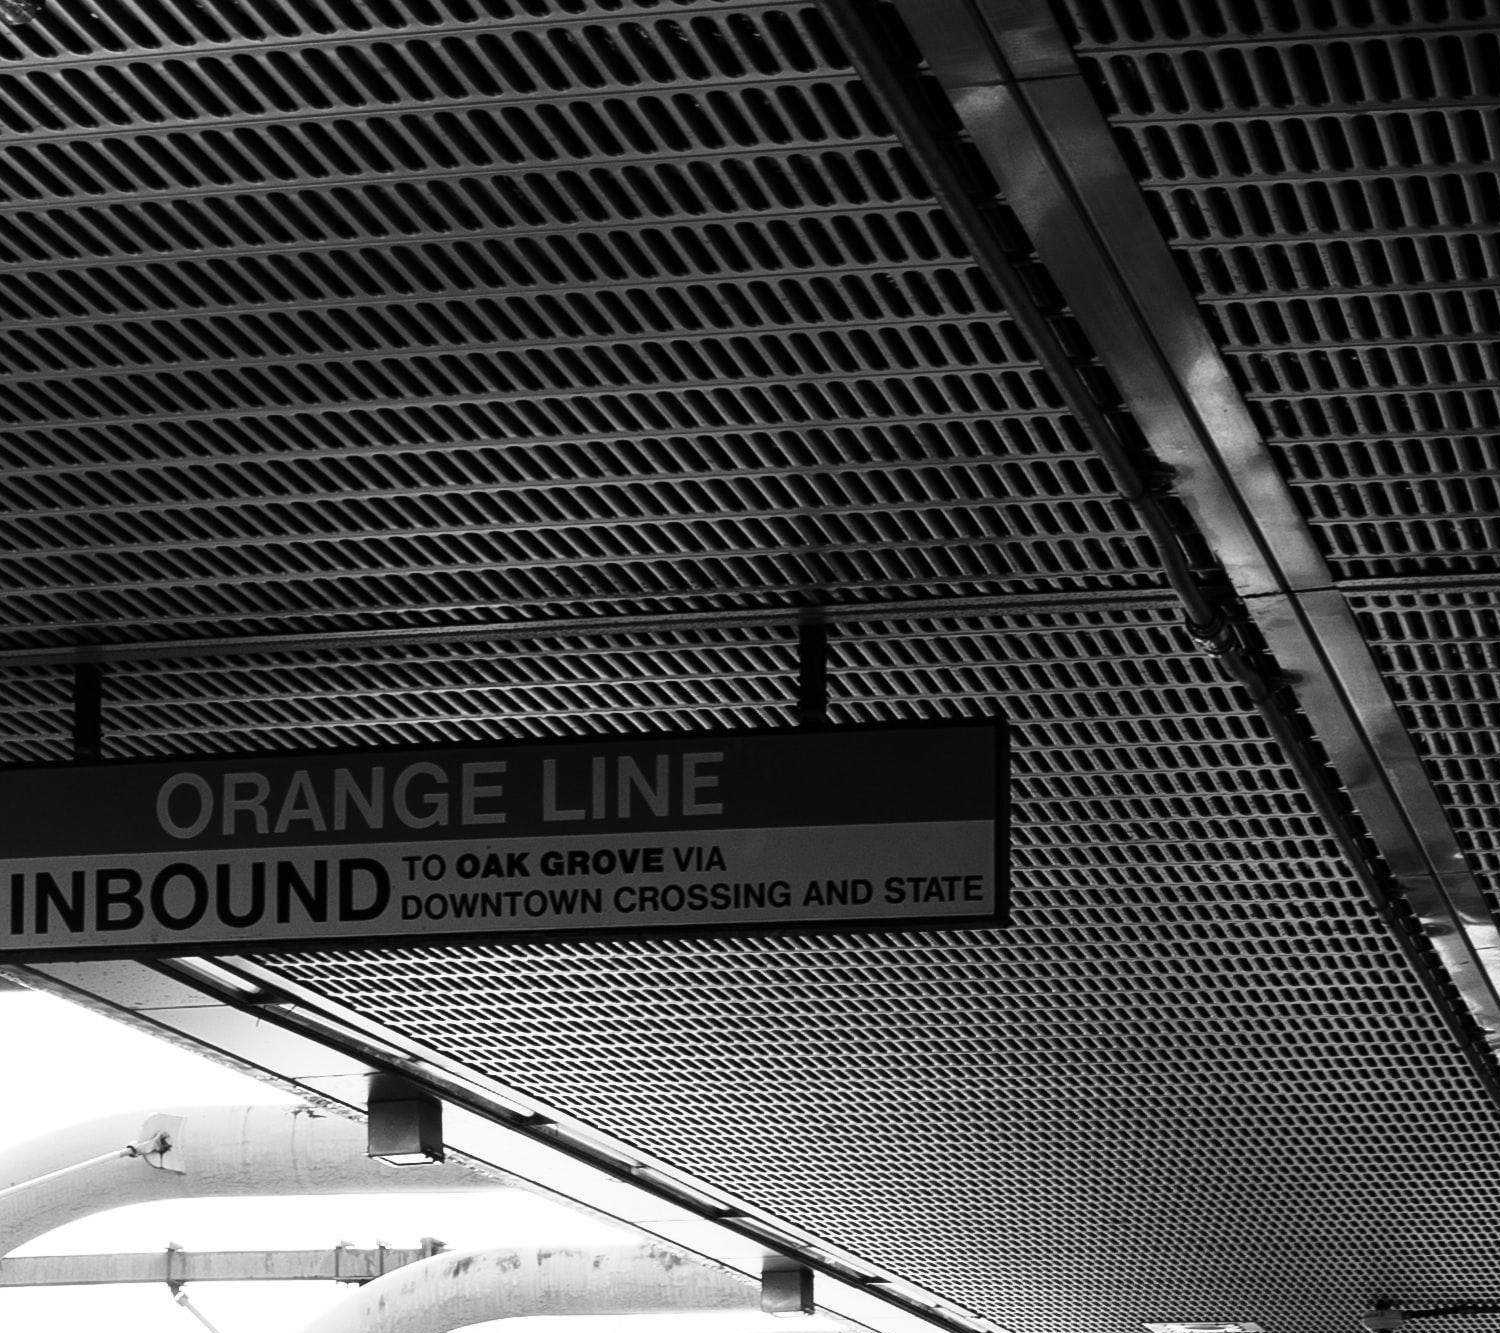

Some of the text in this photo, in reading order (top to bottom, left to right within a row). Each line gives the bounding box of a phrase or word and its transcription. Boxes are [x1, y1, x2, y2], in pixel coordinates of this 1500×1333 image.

[155, 751, 726, 840] ORANGE LINE
[8, 855, 392, 937] INBOUND
[403, 845, 728, 882] TO OAK GROVE VIA
[400, 873, 986, 921] DOWNTOWN CROSSING AND STATE
